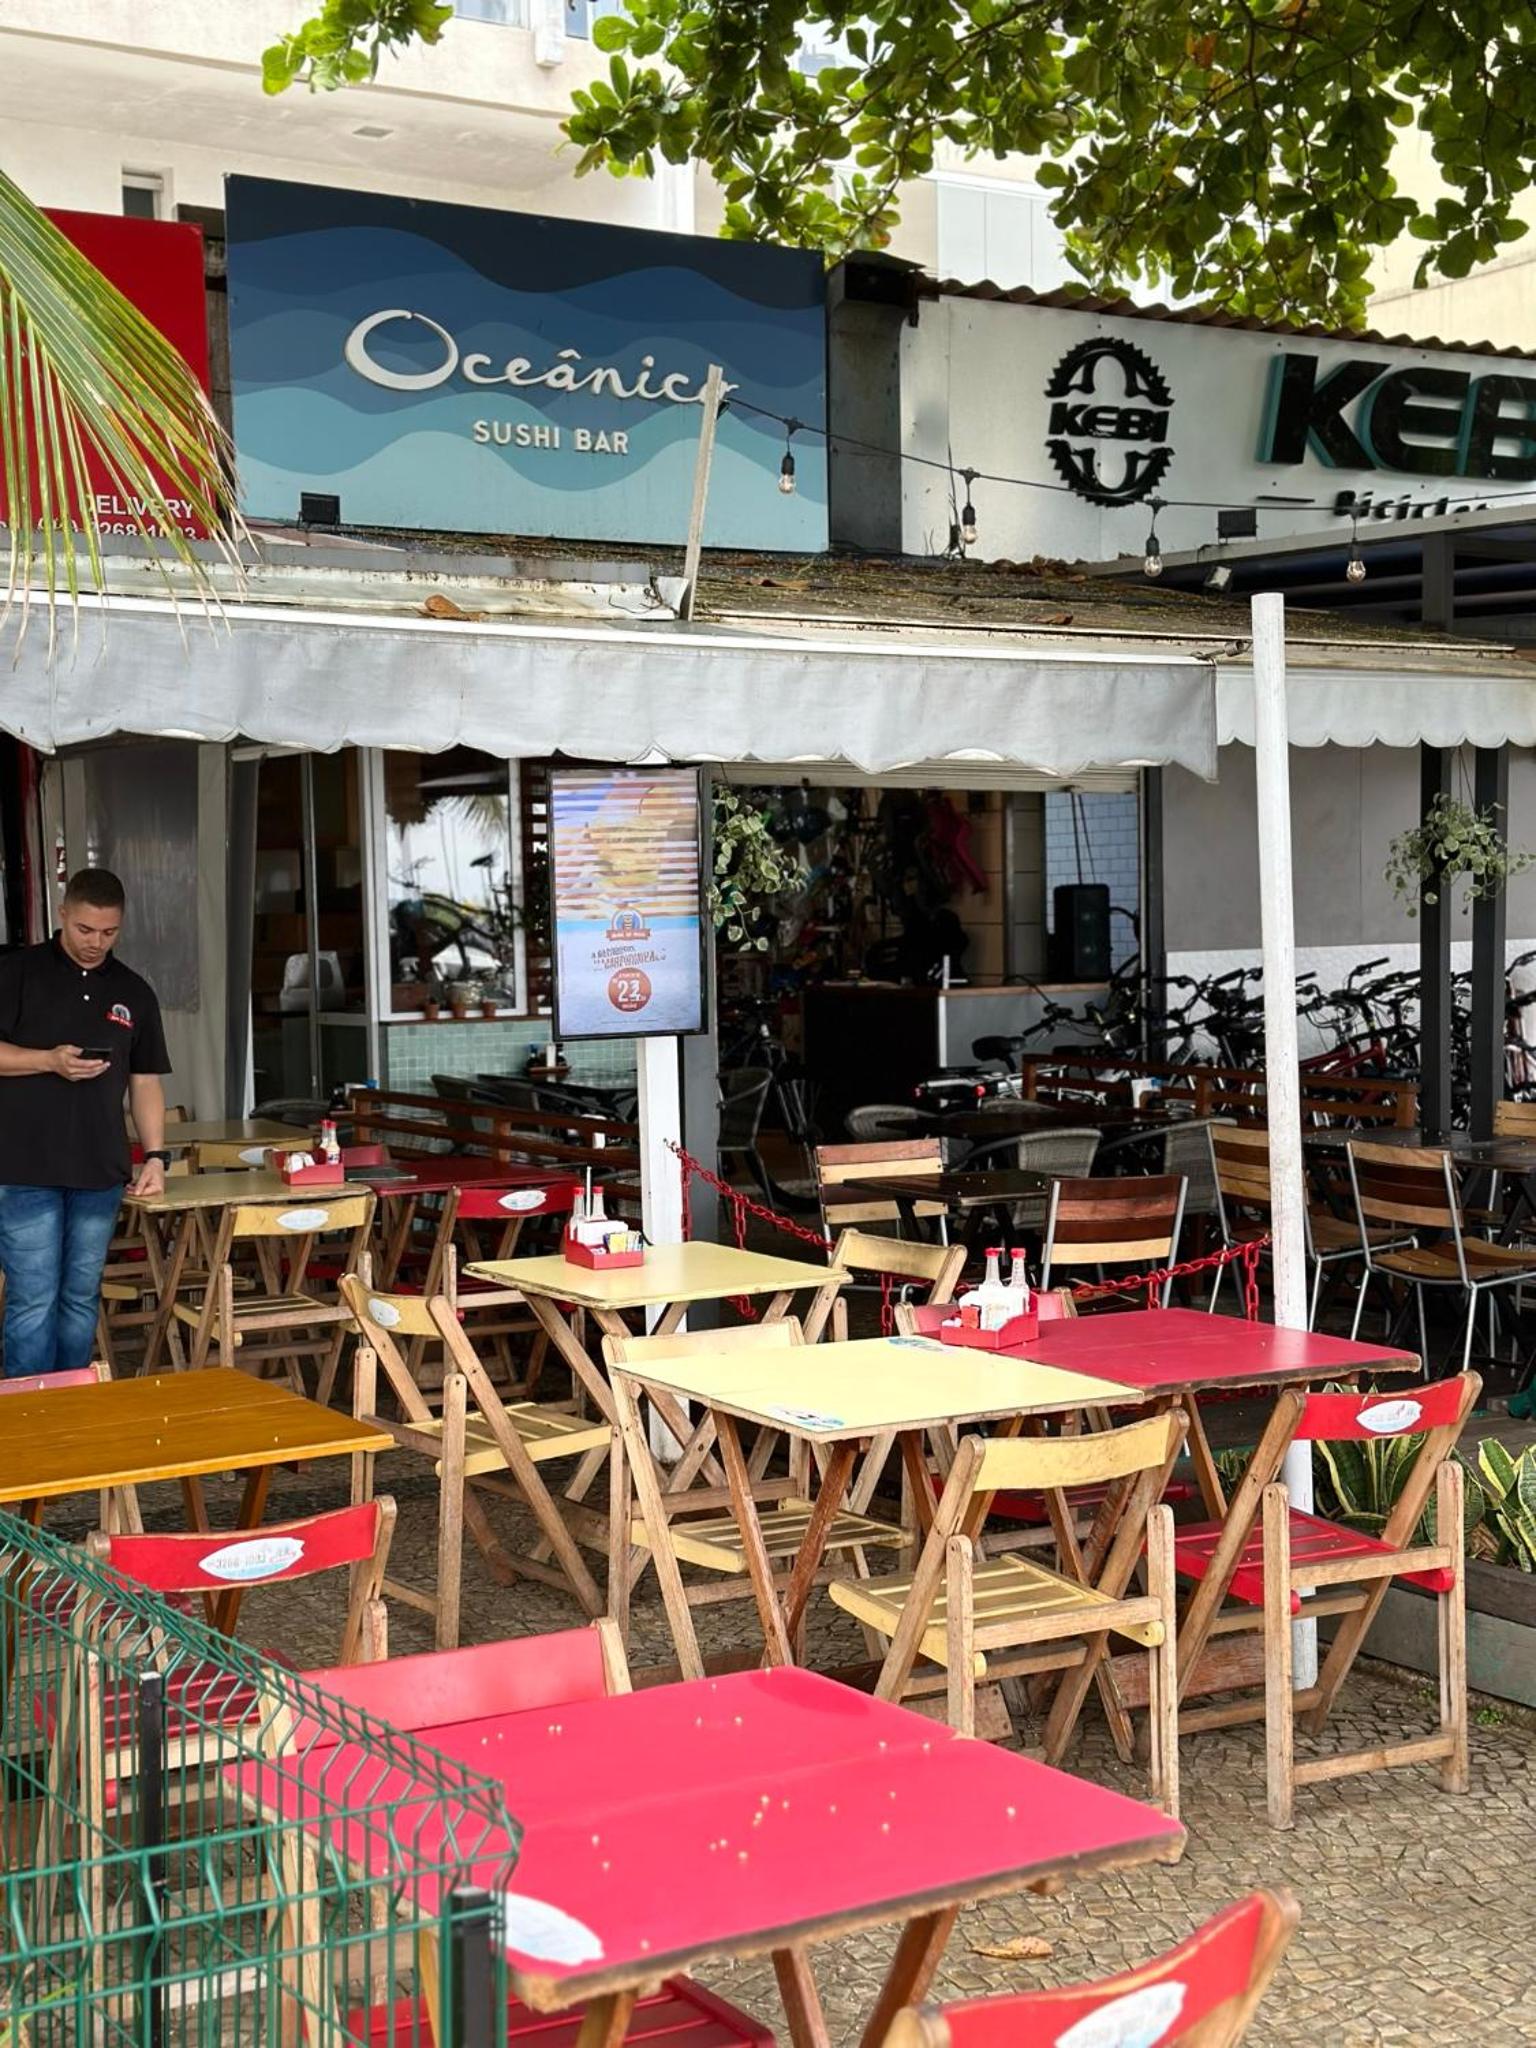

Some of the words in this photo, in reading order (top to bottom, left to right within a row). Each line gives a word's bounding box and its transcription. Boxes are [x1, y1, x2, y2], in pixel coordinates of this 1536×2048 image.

[473, 420, 561, 450] SUSHI
[574, 427, 630, 455] BAR
[1048, 402, 1169, 442] KEBI
[1334, 490, 1490, 520] Bicicl
